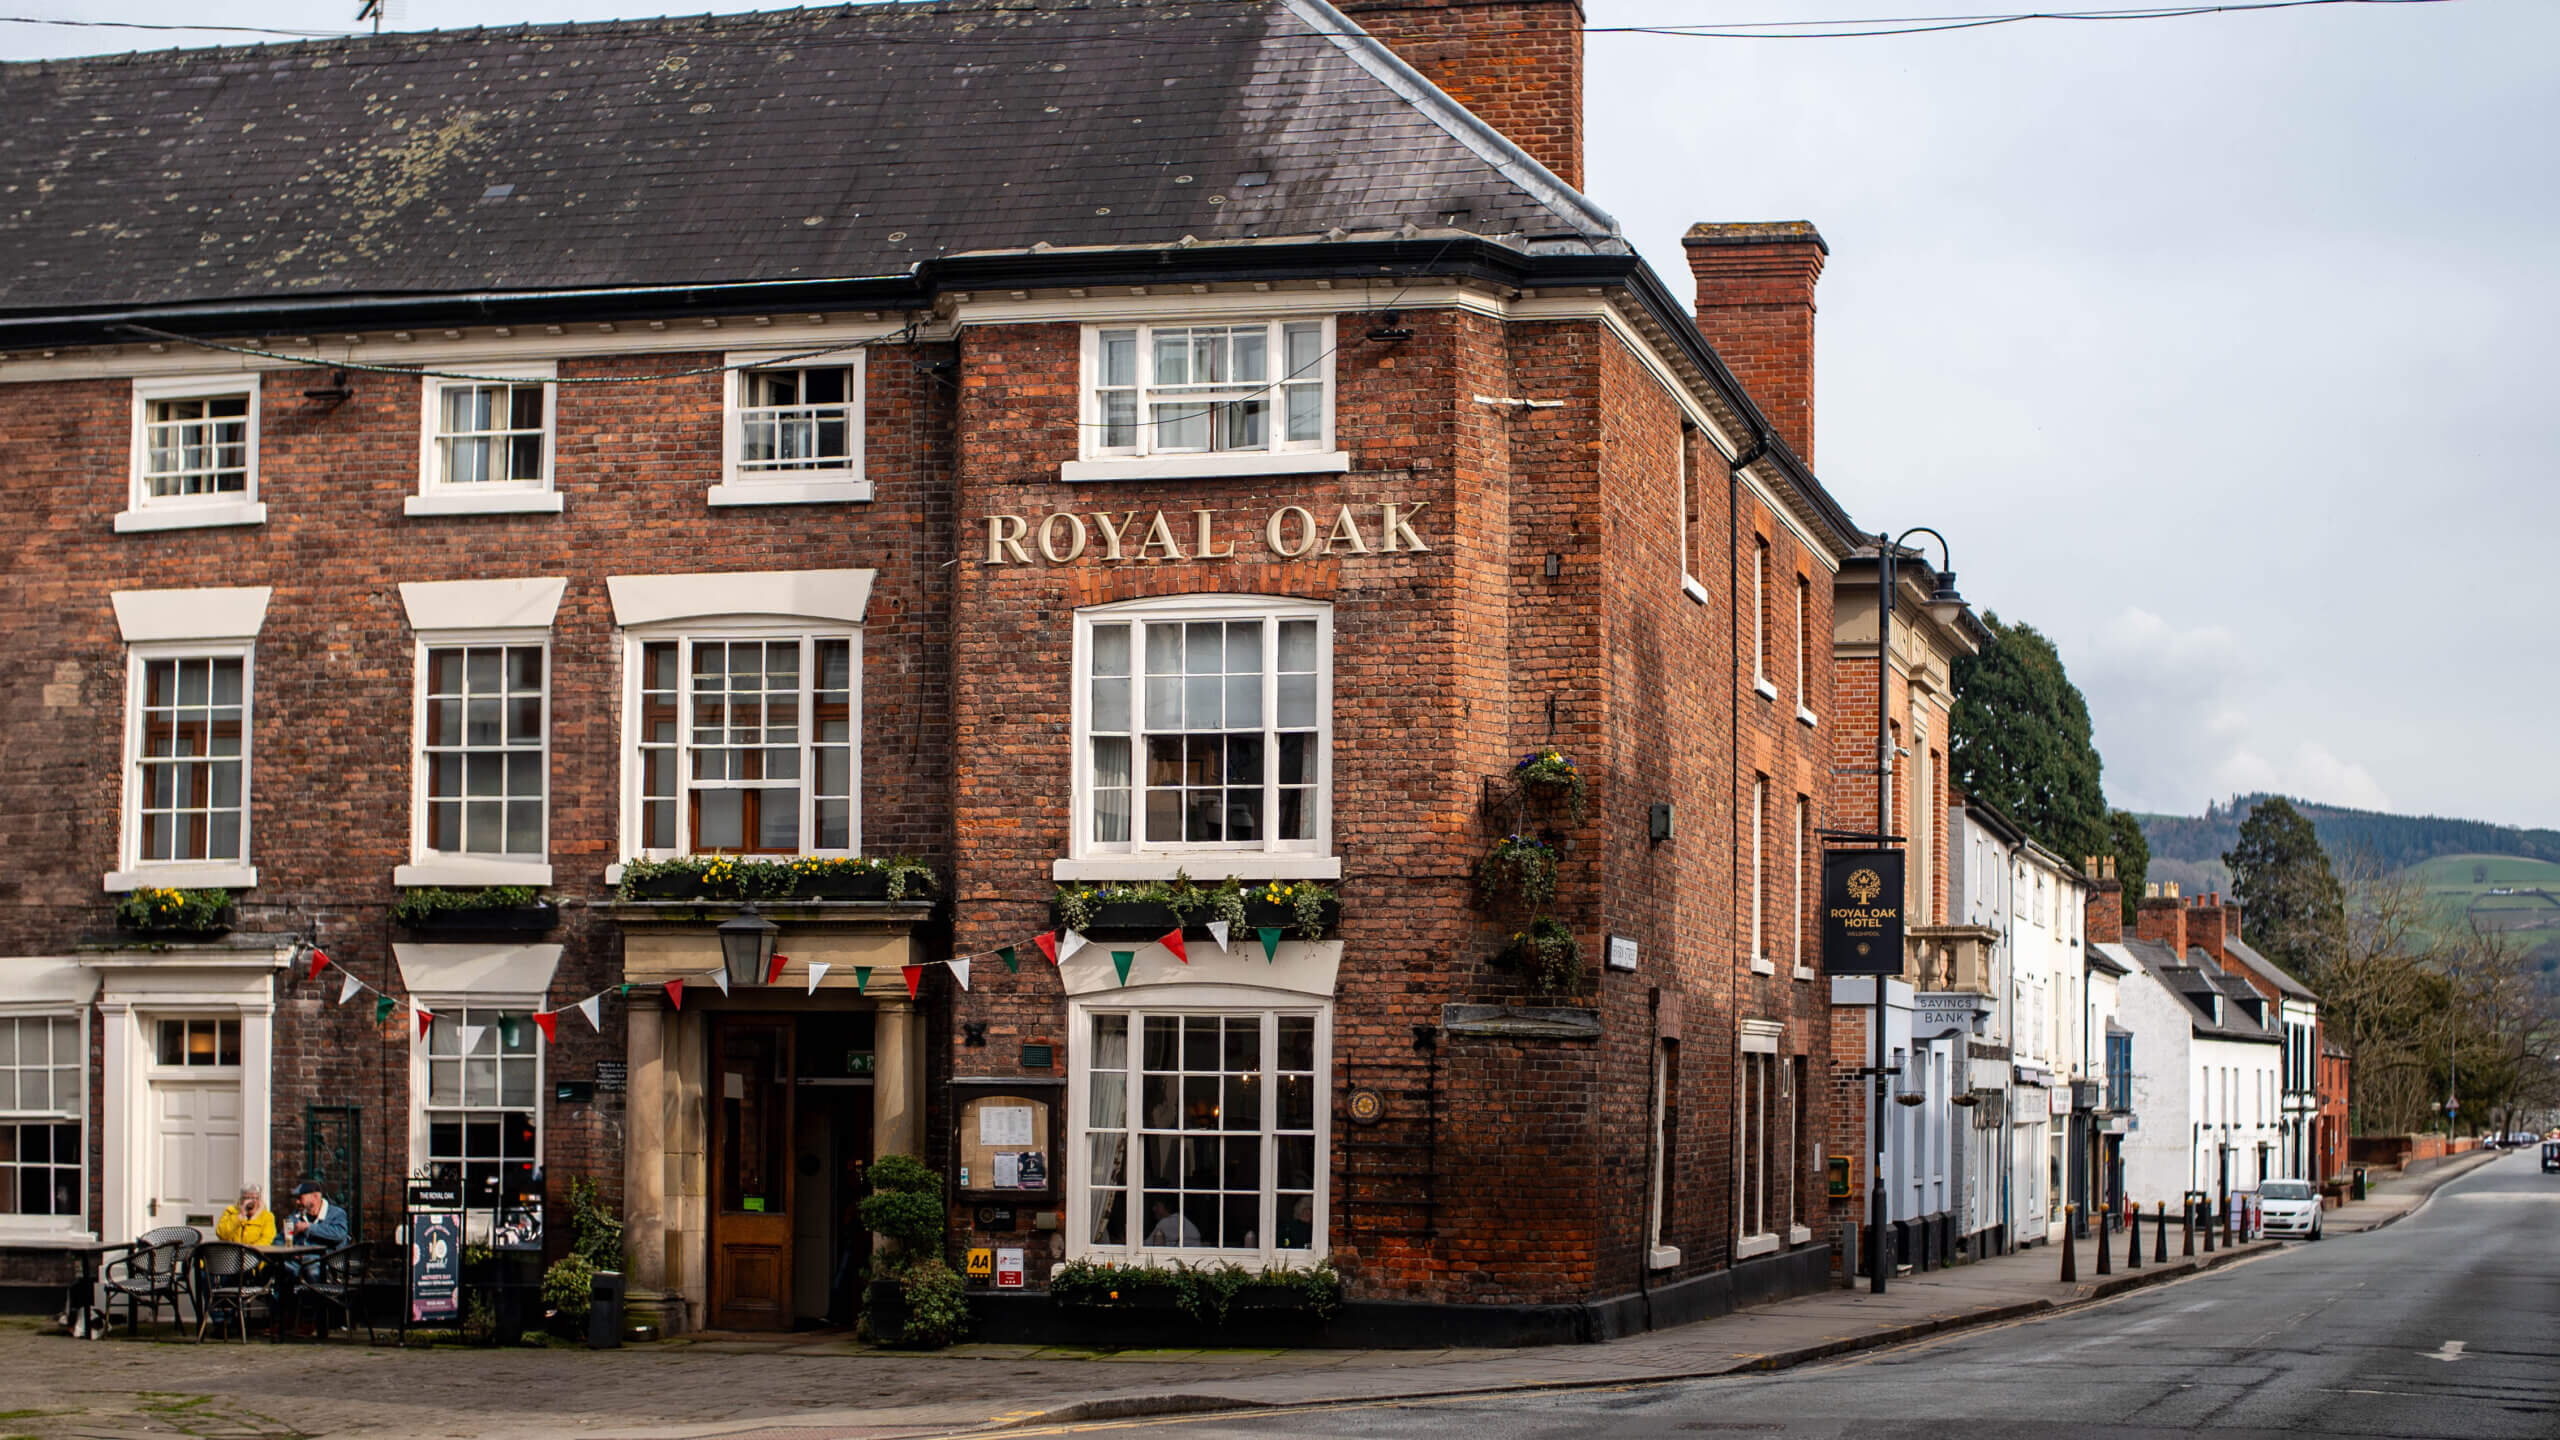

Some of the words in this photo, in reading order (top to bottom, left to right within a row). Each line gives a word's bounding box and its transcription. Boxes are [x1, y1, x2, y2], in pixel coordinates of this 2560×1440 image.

[983, 509, 1235, 565] ROYAL
[1265, 501, 1432, 559] OAK
[1831, 908, 1869, 918] ROYAL
[1871, 908, 1897, 918] OAK
[1844, 918, 1883, 928] HOTEL
[1925, 1012, 1965, 1024] BANK
[970, 1254, 989, 1269] AA
